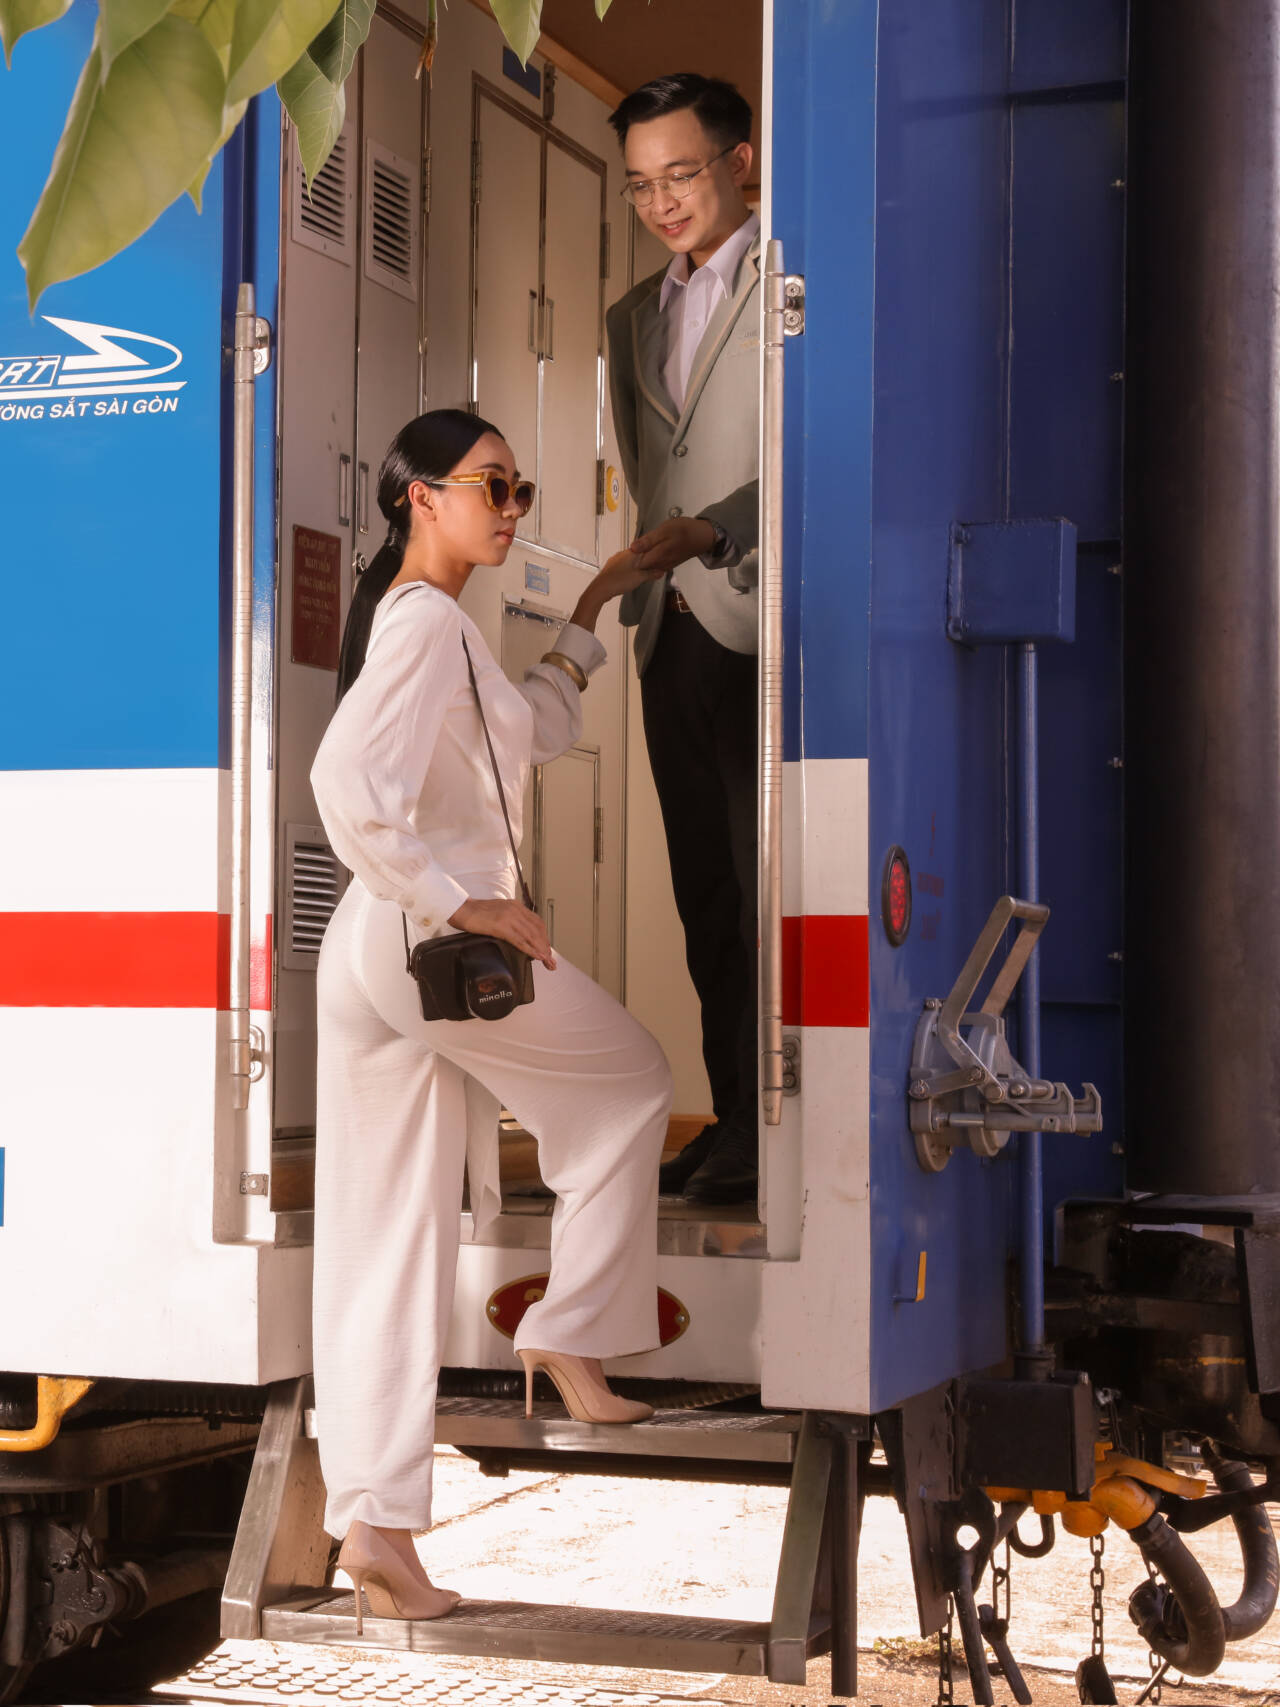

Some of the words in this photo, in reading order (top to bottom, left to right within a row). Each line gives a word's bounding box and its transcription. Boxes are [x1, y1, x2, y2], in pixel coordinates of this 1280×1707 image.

[49, 396, 91, 418] SẮT
[94, 396, 129, 416] SÀI
[132, 394, 179, 415] GÒN
